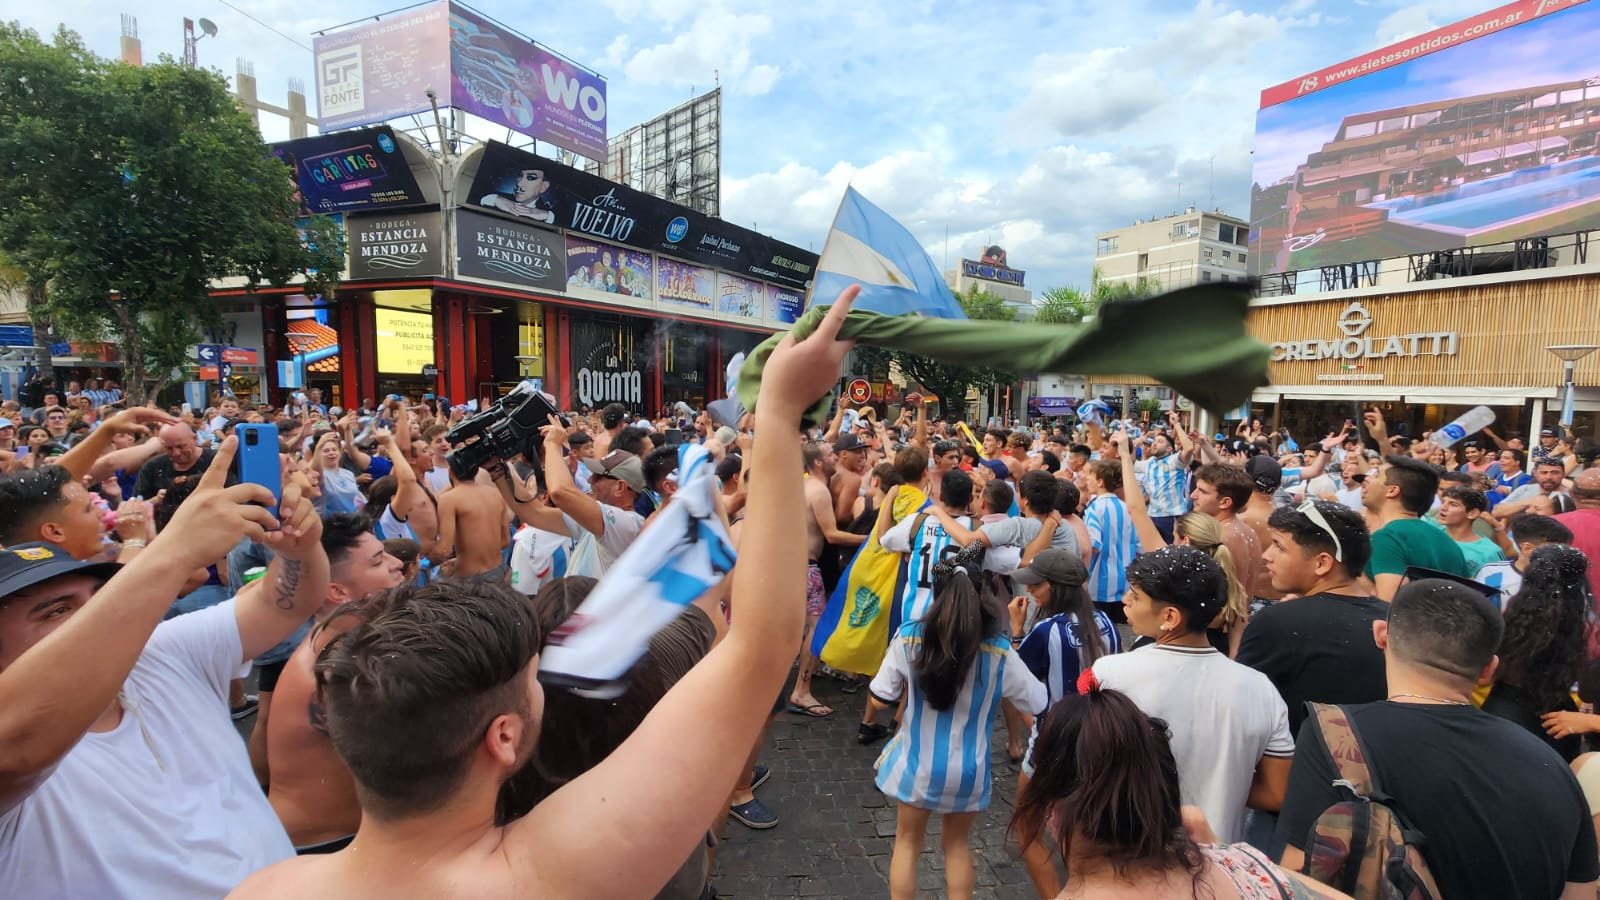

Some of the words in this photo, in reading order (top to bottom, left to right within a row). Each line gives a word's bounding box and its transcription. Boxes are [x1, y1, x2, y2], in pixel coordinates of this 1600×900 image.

[1325, 9, 1524, 83] www.sietesentidos.com.ar
[324, 88, 360, 106] FONTE
[541, 63, 606, 122] WO
[375, 220, 411, 229] BODEGA
[571, 202, 635, 241] VUELVO
[360, 228, 427, 242] ESTANCIA
[477, 231, 551, 257] ESTANCIA
[495, 226, 535, 242] BODEGA
[361, 242, 428, 257] MENDOZA
[477, 246, 551, 270] MENDOZA
[1270, 331, 1459, 362] CREMOLATTI
[606, 356, 618, 368] LA
